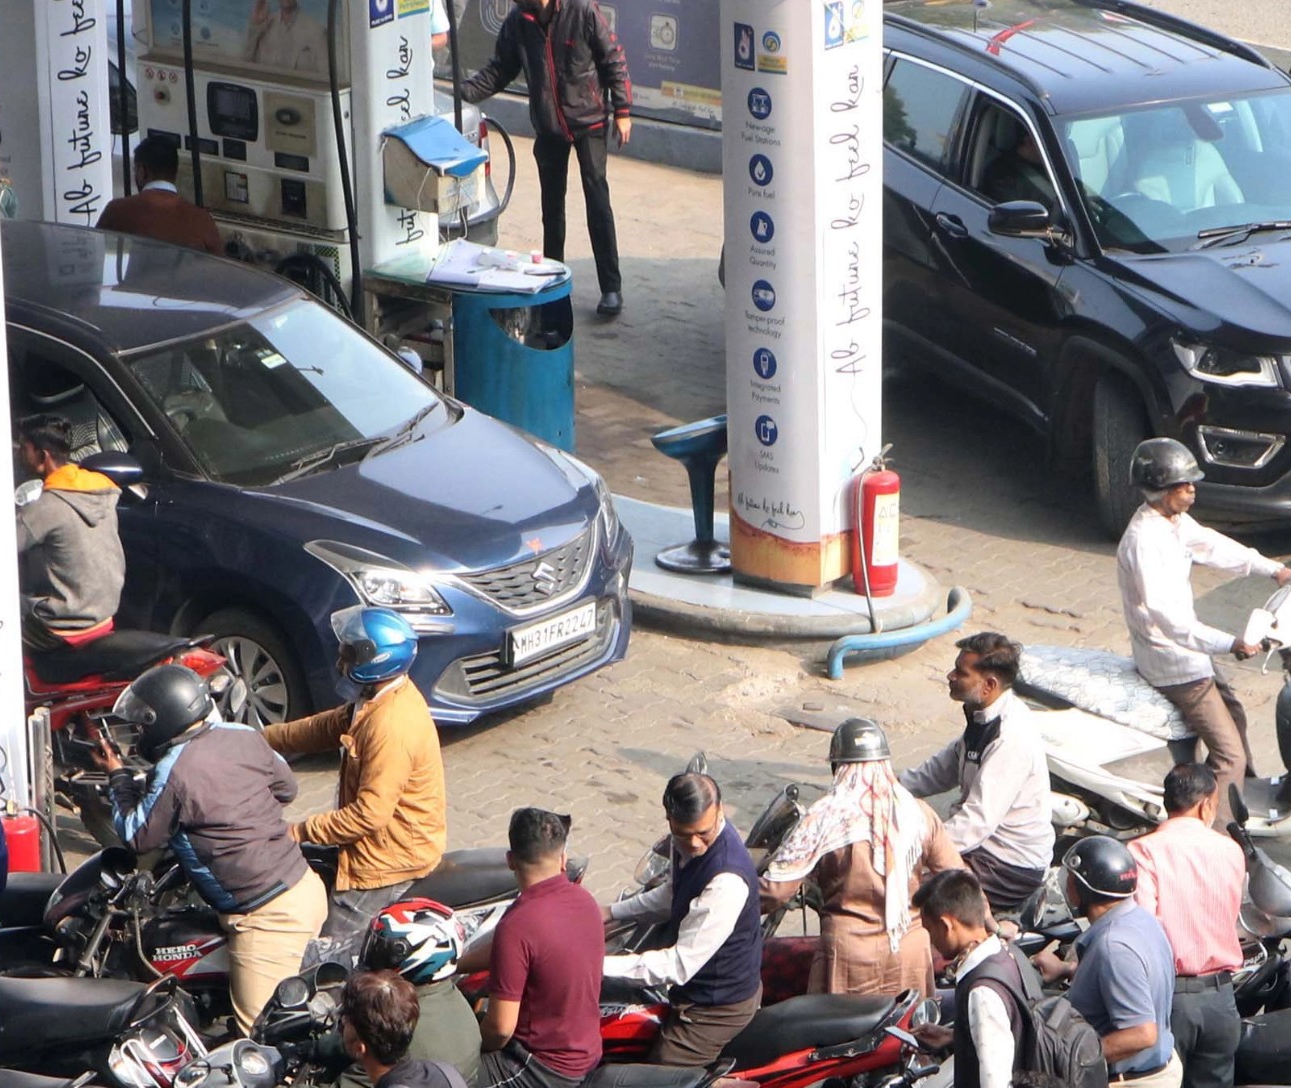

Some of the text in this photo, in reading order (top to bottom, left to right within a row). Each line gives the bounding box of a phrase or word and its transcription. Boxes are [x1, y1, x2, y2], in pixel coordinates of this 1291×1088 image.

[60, 0, 96, 37] fee
[520, 609, 594, 652] MH31FR2247
[152, 950, 203, 962] HONDA
[156, 944, 196, 954] HERO
